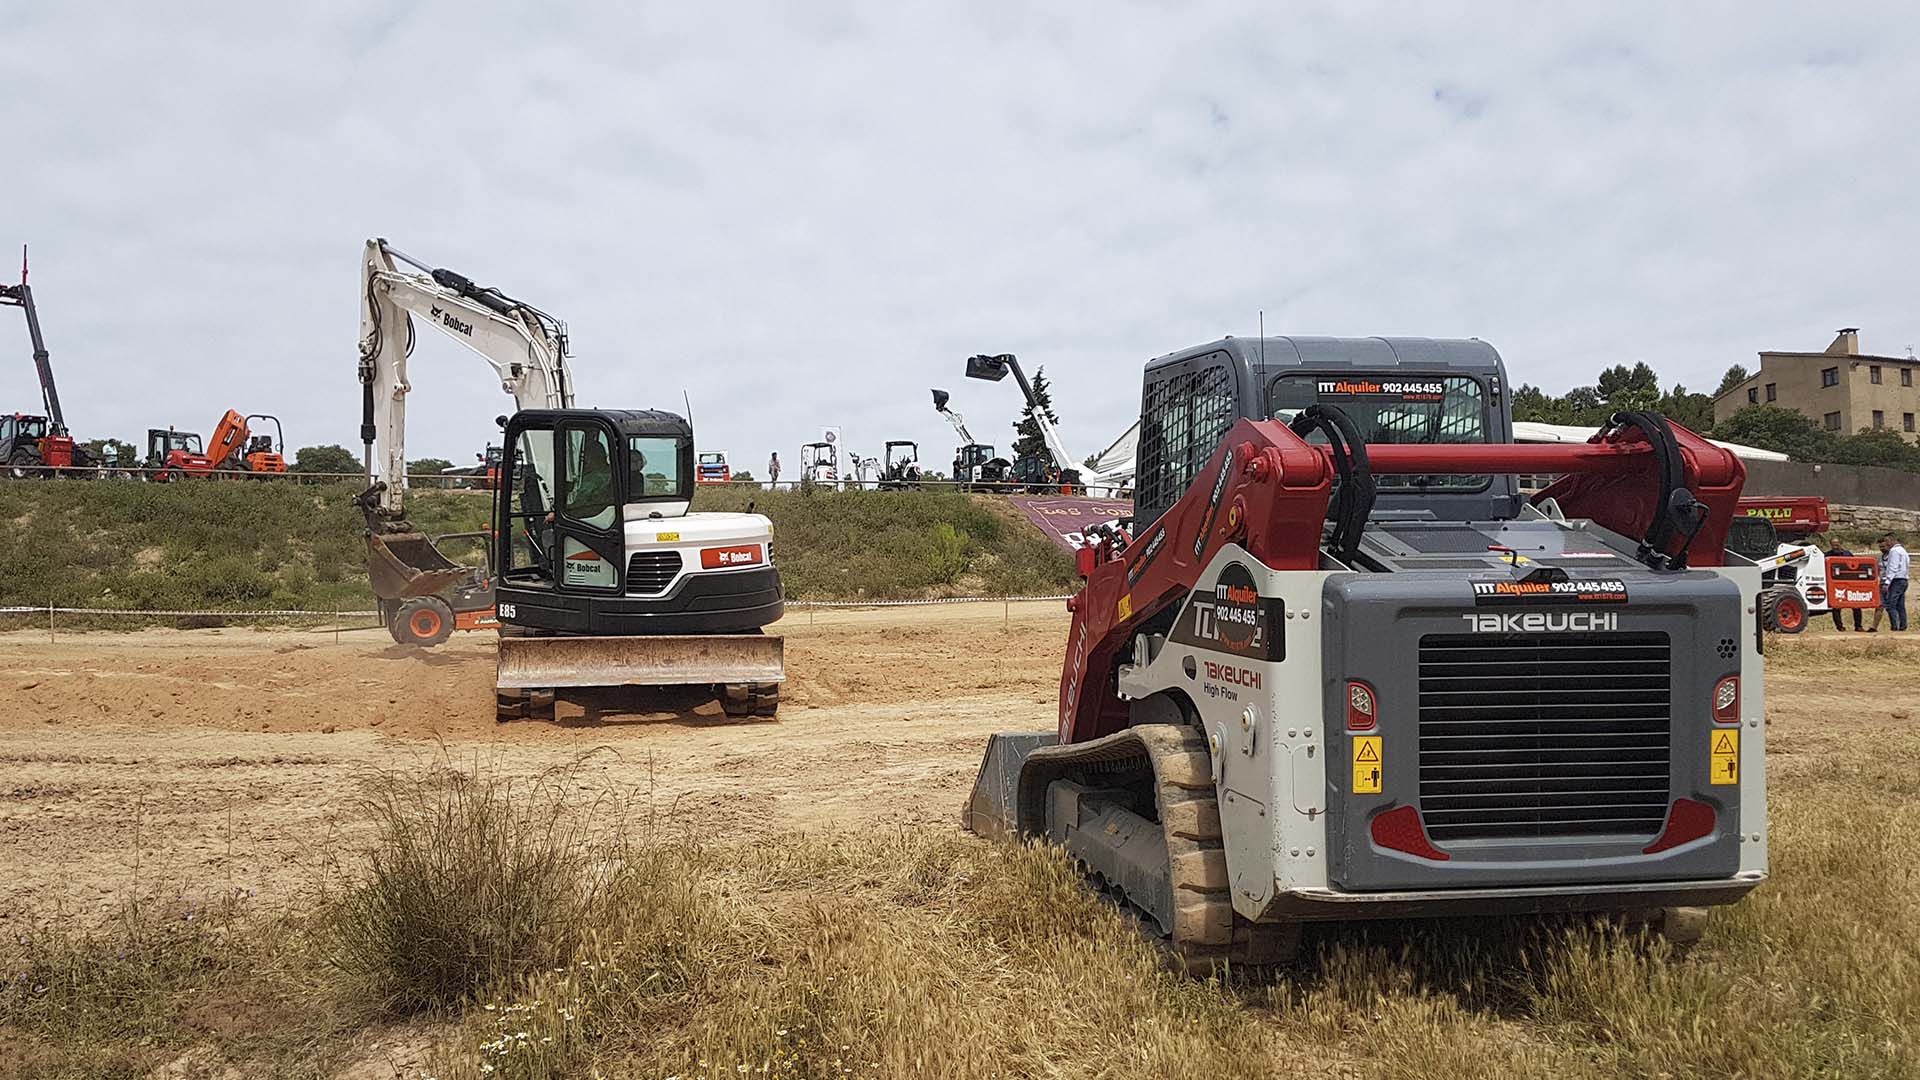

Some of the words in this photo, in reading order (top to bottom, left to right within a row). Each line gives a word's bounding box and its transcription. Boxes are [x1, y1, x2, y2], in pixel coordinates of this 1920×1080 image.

[443, 312, 473, 337] Bobcat
[730, 551, 752, 563] Bobcat
[576, 563, 601, 573] Bobcat
[1847, 590, 1874, 602] Bobcat
[499, 603, 516, 619] E85
[1203, 681, 1219, 698] High
[1221, 685, 1238, 701] Flow
